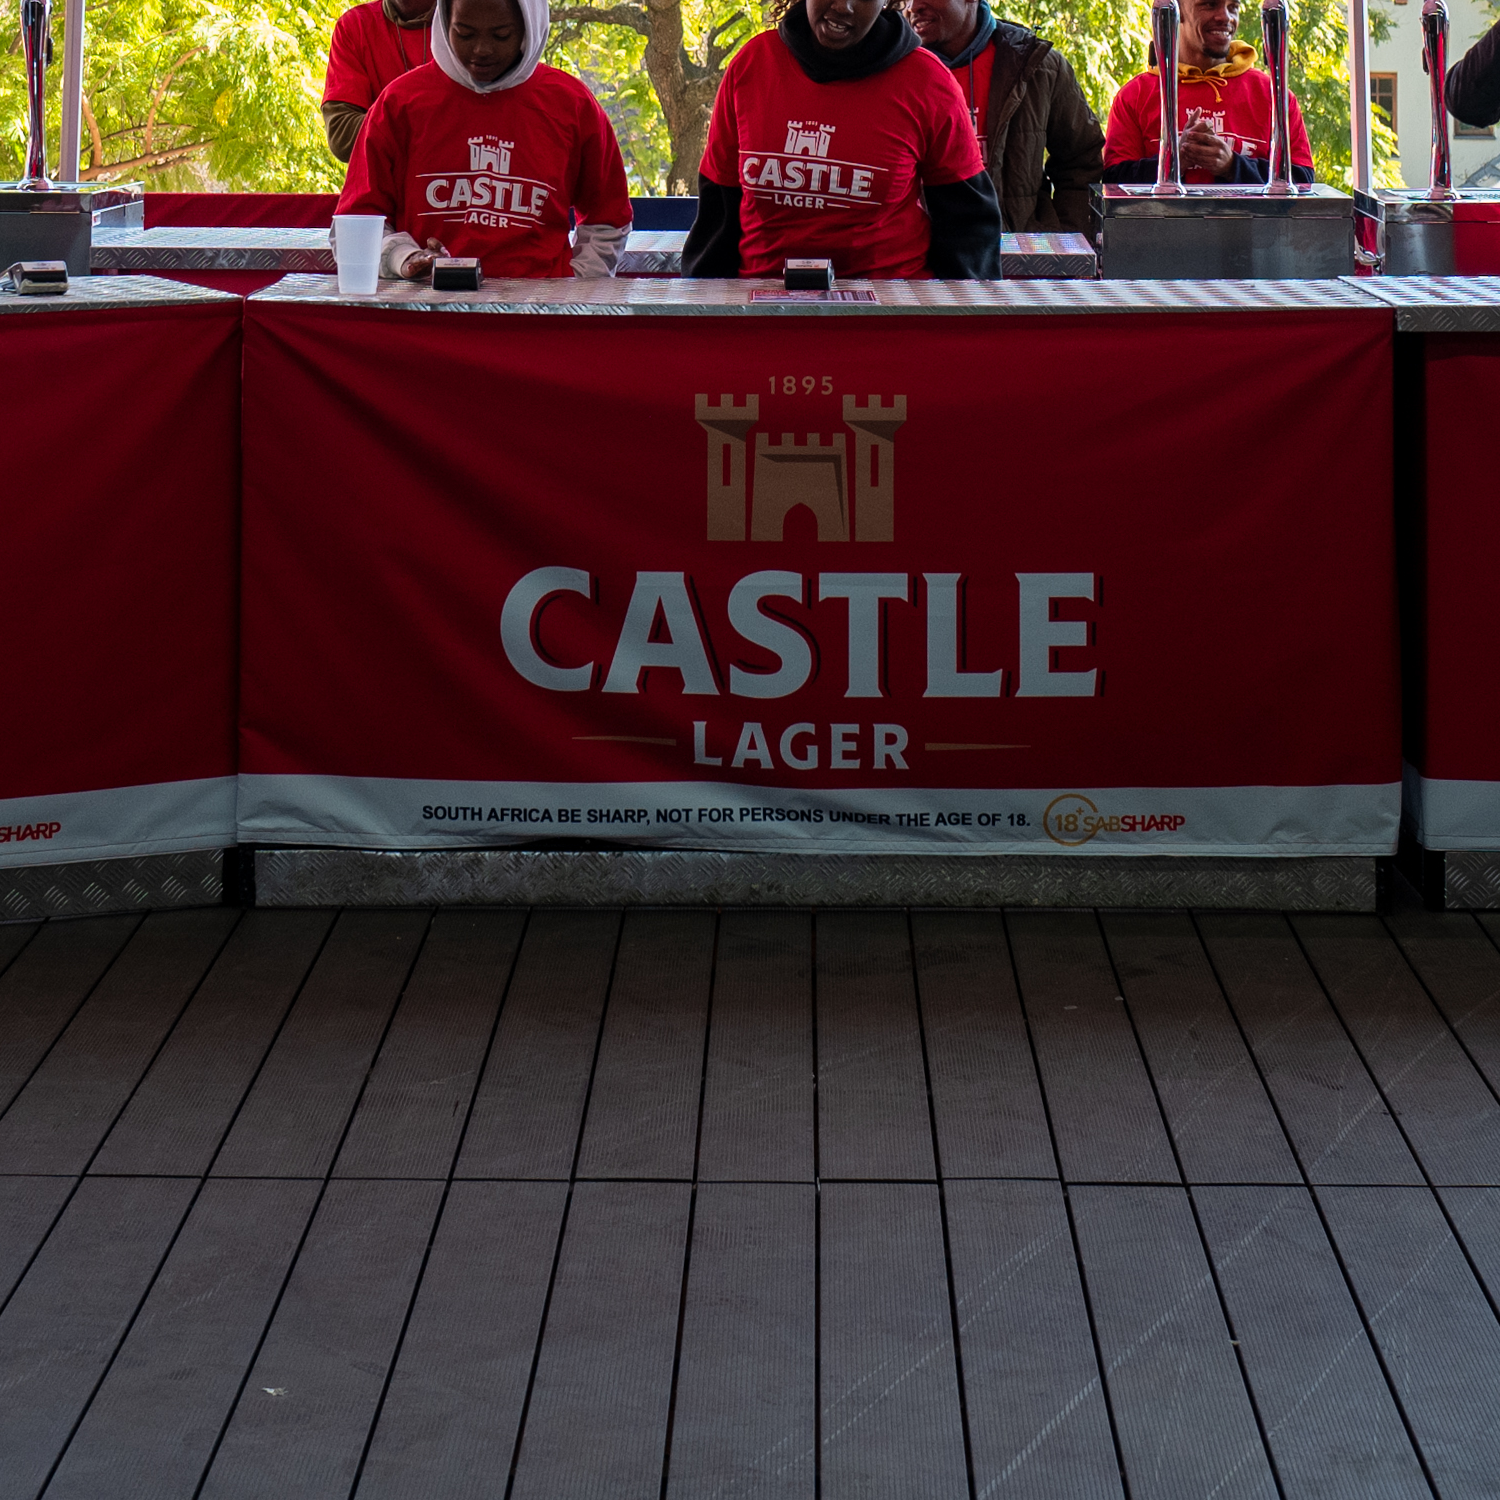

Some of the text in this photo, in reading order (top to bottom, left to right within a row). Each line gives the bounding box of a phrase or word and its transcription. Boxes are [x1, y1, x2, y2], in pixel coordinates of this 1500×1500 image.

[426, 176, 549, 216] CASTLE
[742, 157, 874, 198] CASTLE
[774, 193, 825, 209] LAGER
[768, 376, 835, 395] 1895
[501, 566, 1098, 698] CASTLE
[692, 720, 910, 770] LAGER
[422, 806, 1031, 828] SOUTH AFRICA BE SHARP, NOT FOR PERSONS UNDER THE AGE OF 18.
